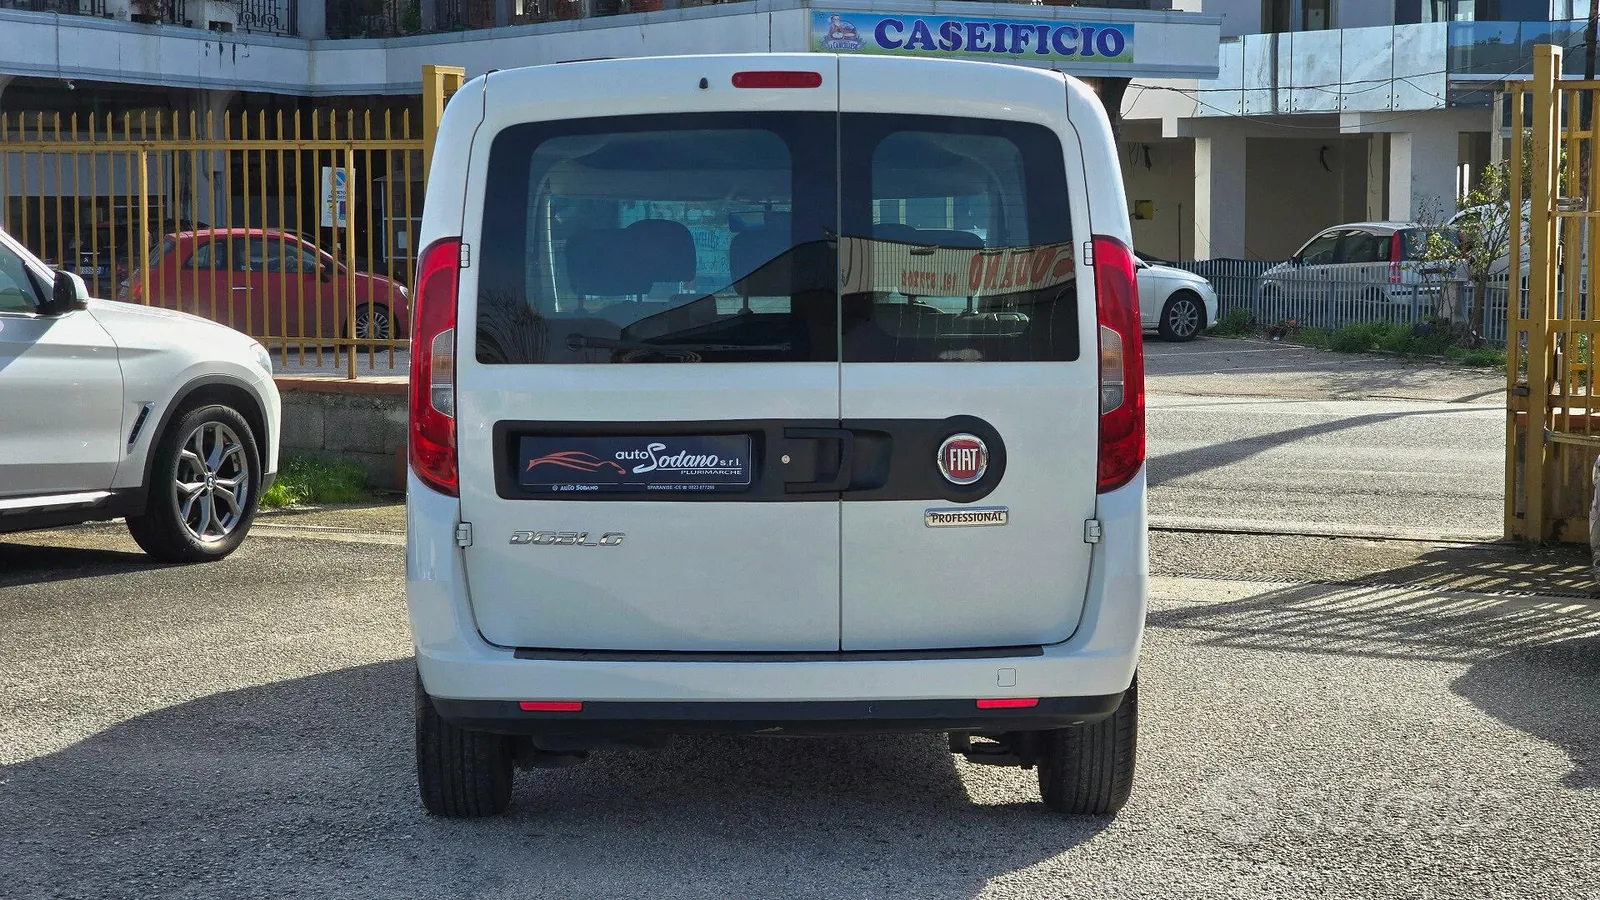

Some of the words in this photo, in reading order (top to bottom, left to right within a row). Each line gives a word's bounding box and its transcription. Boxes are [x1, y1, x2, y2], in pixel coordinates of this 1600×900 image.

[873, 17, 1126, 57] CASEIFICIO
[615, 449, 649, 460] auto
[633, 443, 718, 474] Sodano
[950, 448, 978, 471] FIAT
[932, 511, 1003, 523] PROFESSIONAL
[509, 530, 626, 546] DOBLO
